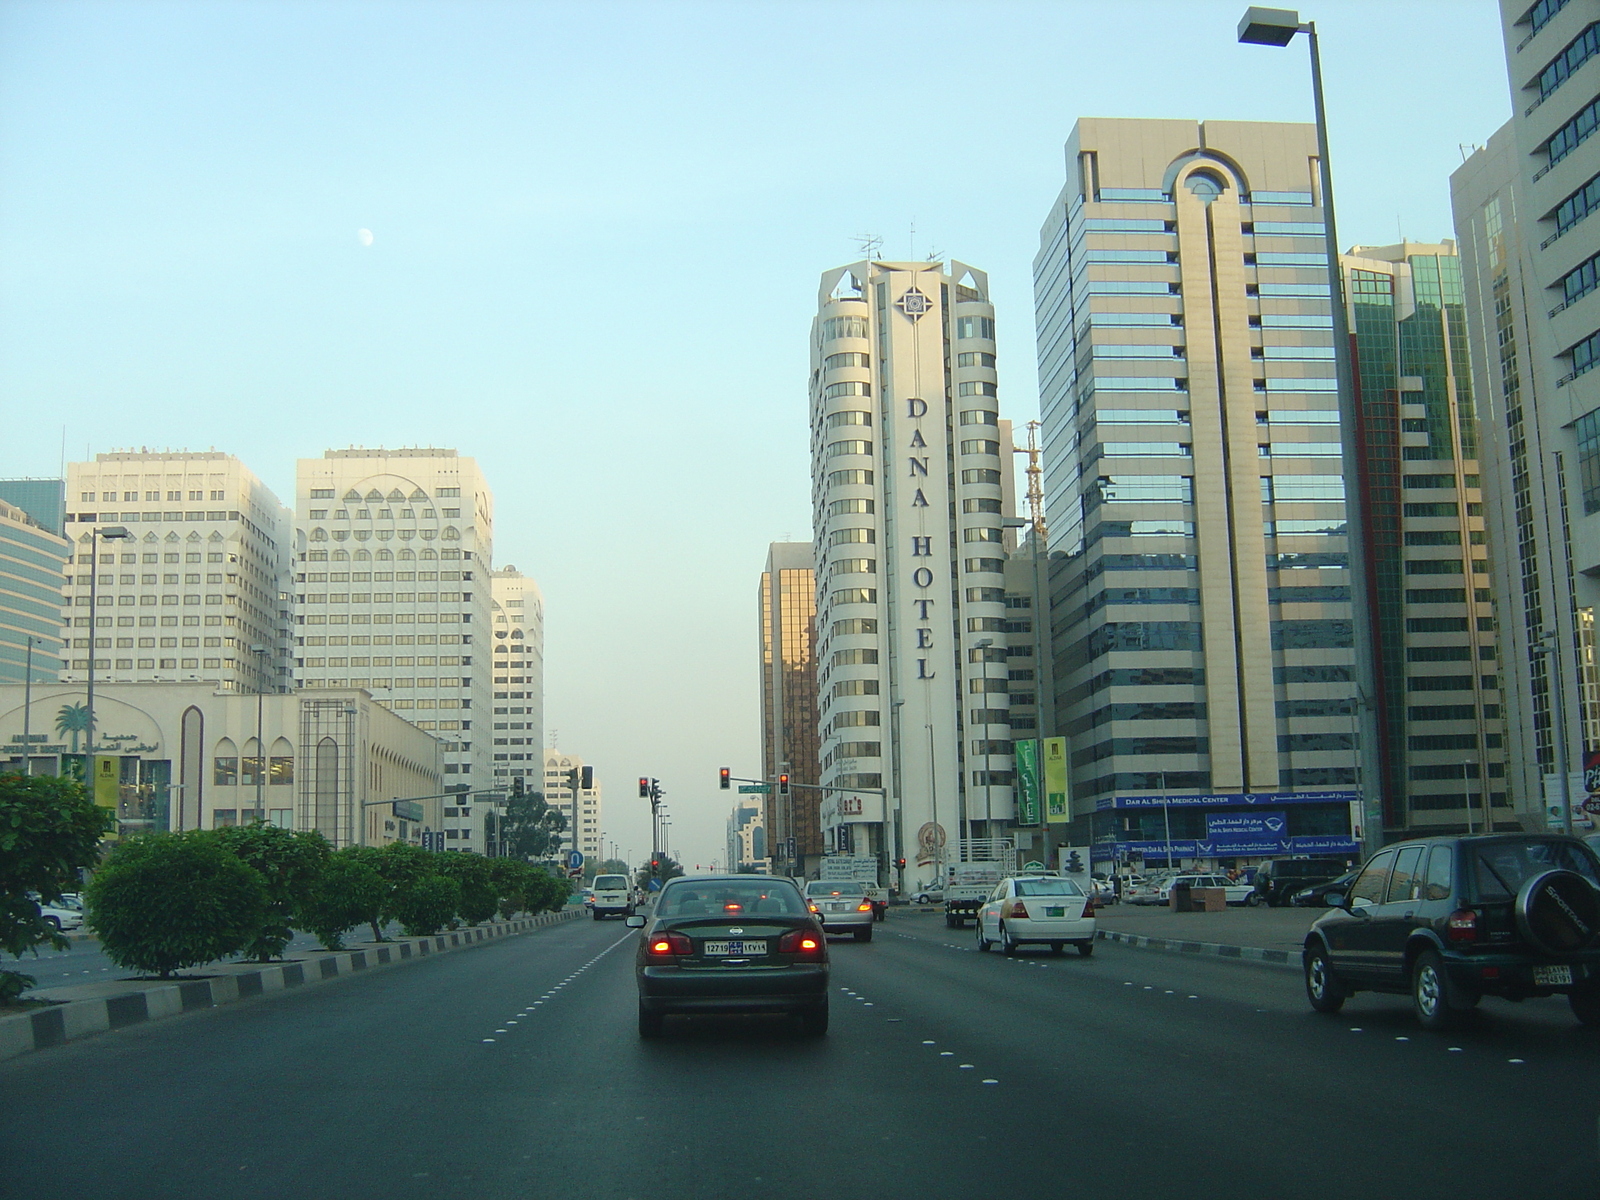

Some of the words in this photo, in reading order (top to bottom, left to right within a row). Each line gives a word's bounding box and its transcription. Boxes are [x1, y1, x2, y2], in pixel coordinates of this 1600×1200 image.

[906, 397, 929, 507] DANA
[912, 536, 935, 679] HOTEL
[707, 945, 729, 953] 12719
[1545, 885, 1590, 935] SPORTAGE
